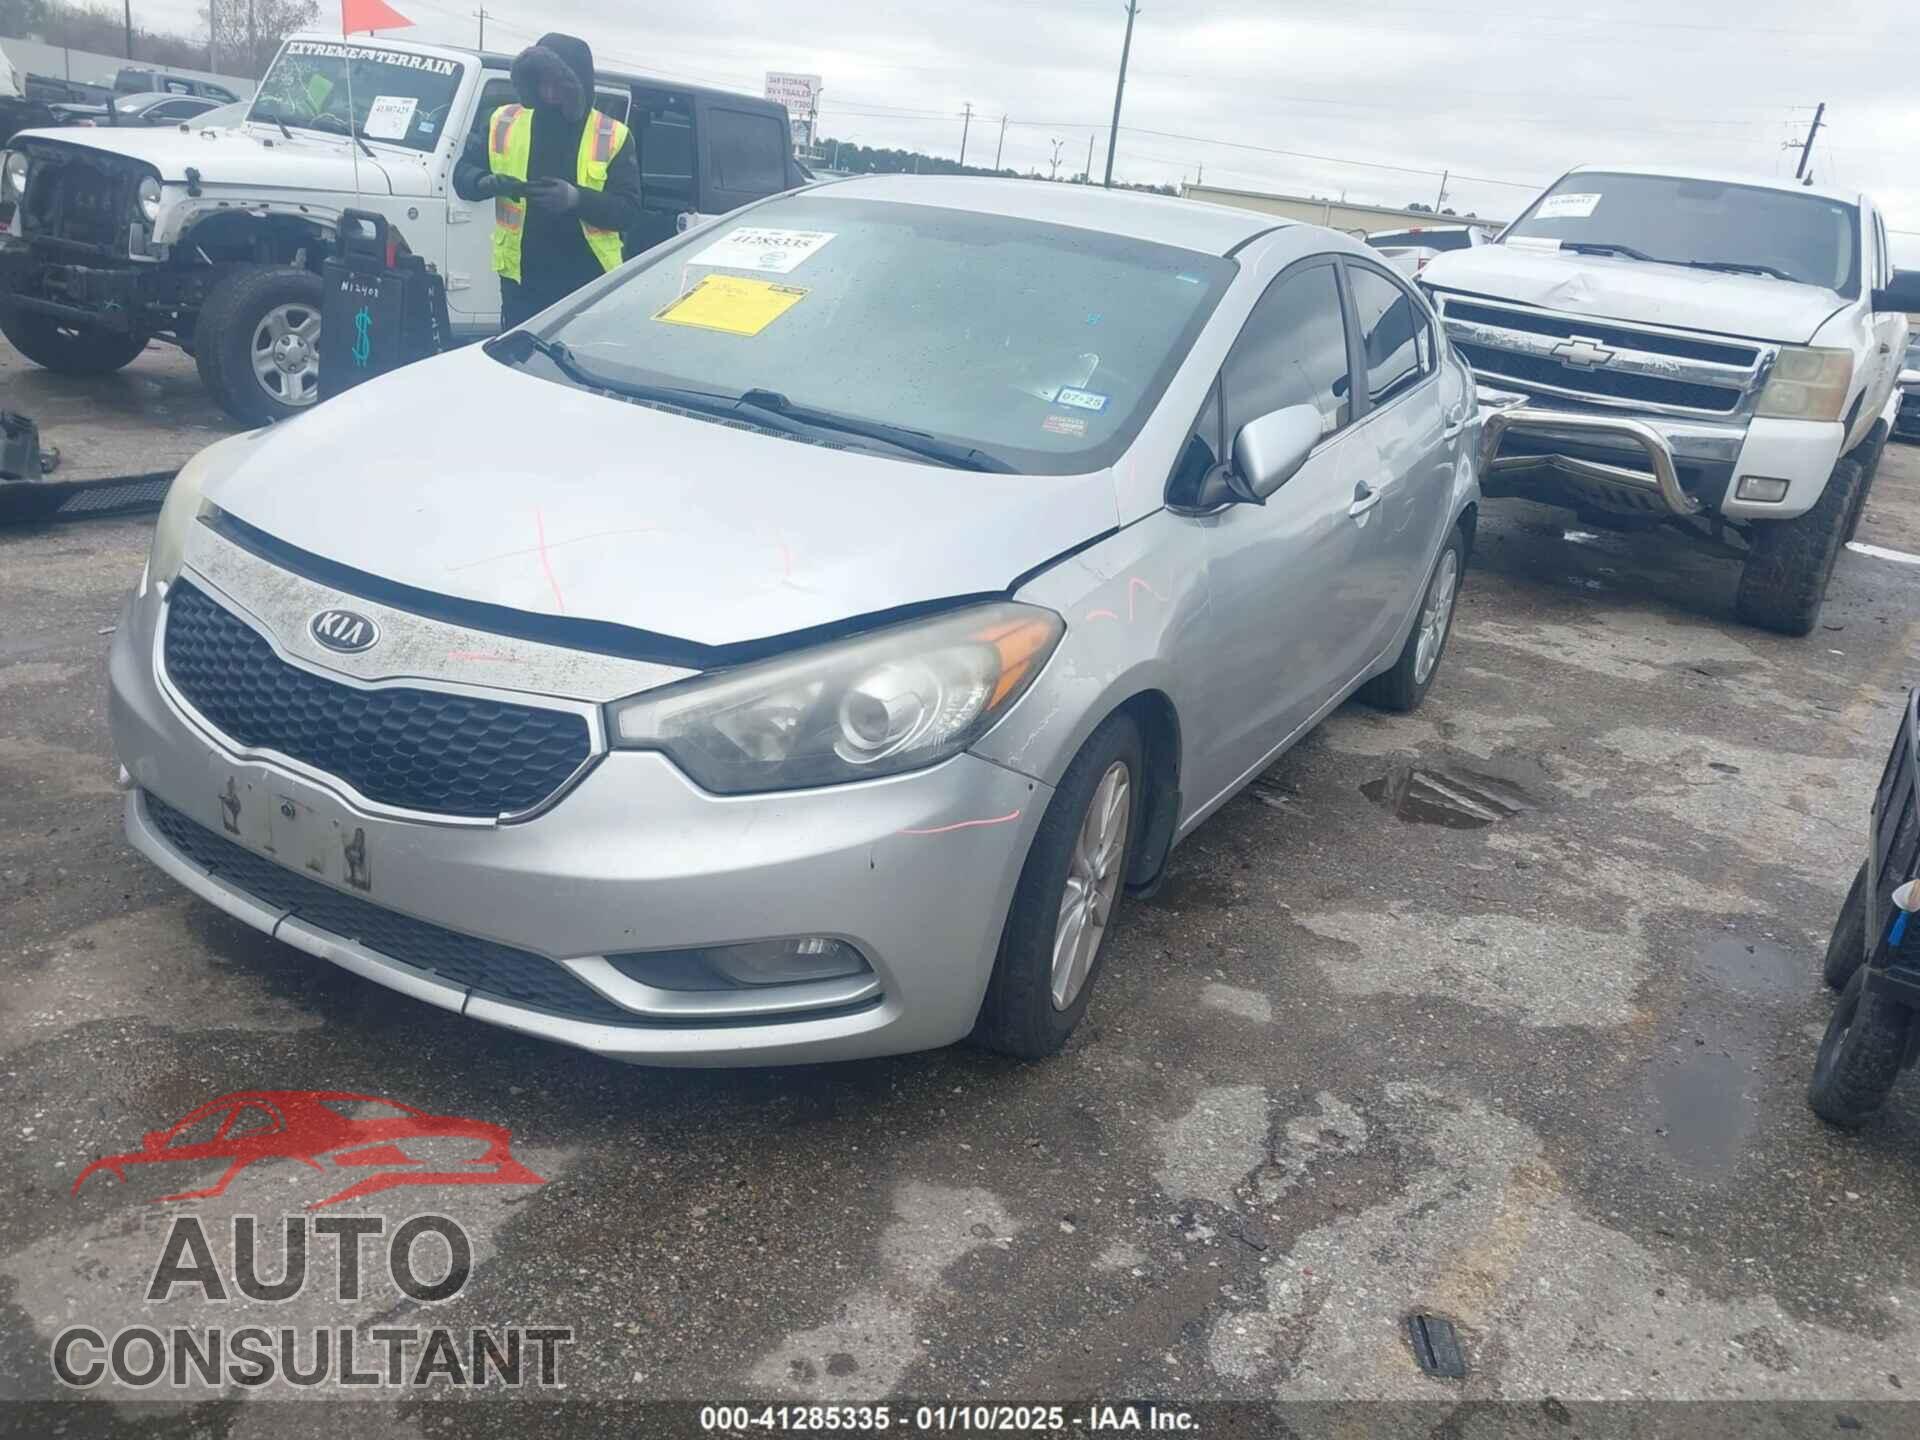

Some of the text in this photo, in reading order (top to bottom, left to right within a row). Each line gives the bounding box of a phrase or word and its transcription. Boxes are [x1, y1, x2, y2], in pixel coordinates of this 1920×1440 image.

[286, 42, 456, 76] EXTREME TERRAIN
[317, 612, 364, 644] KIA
